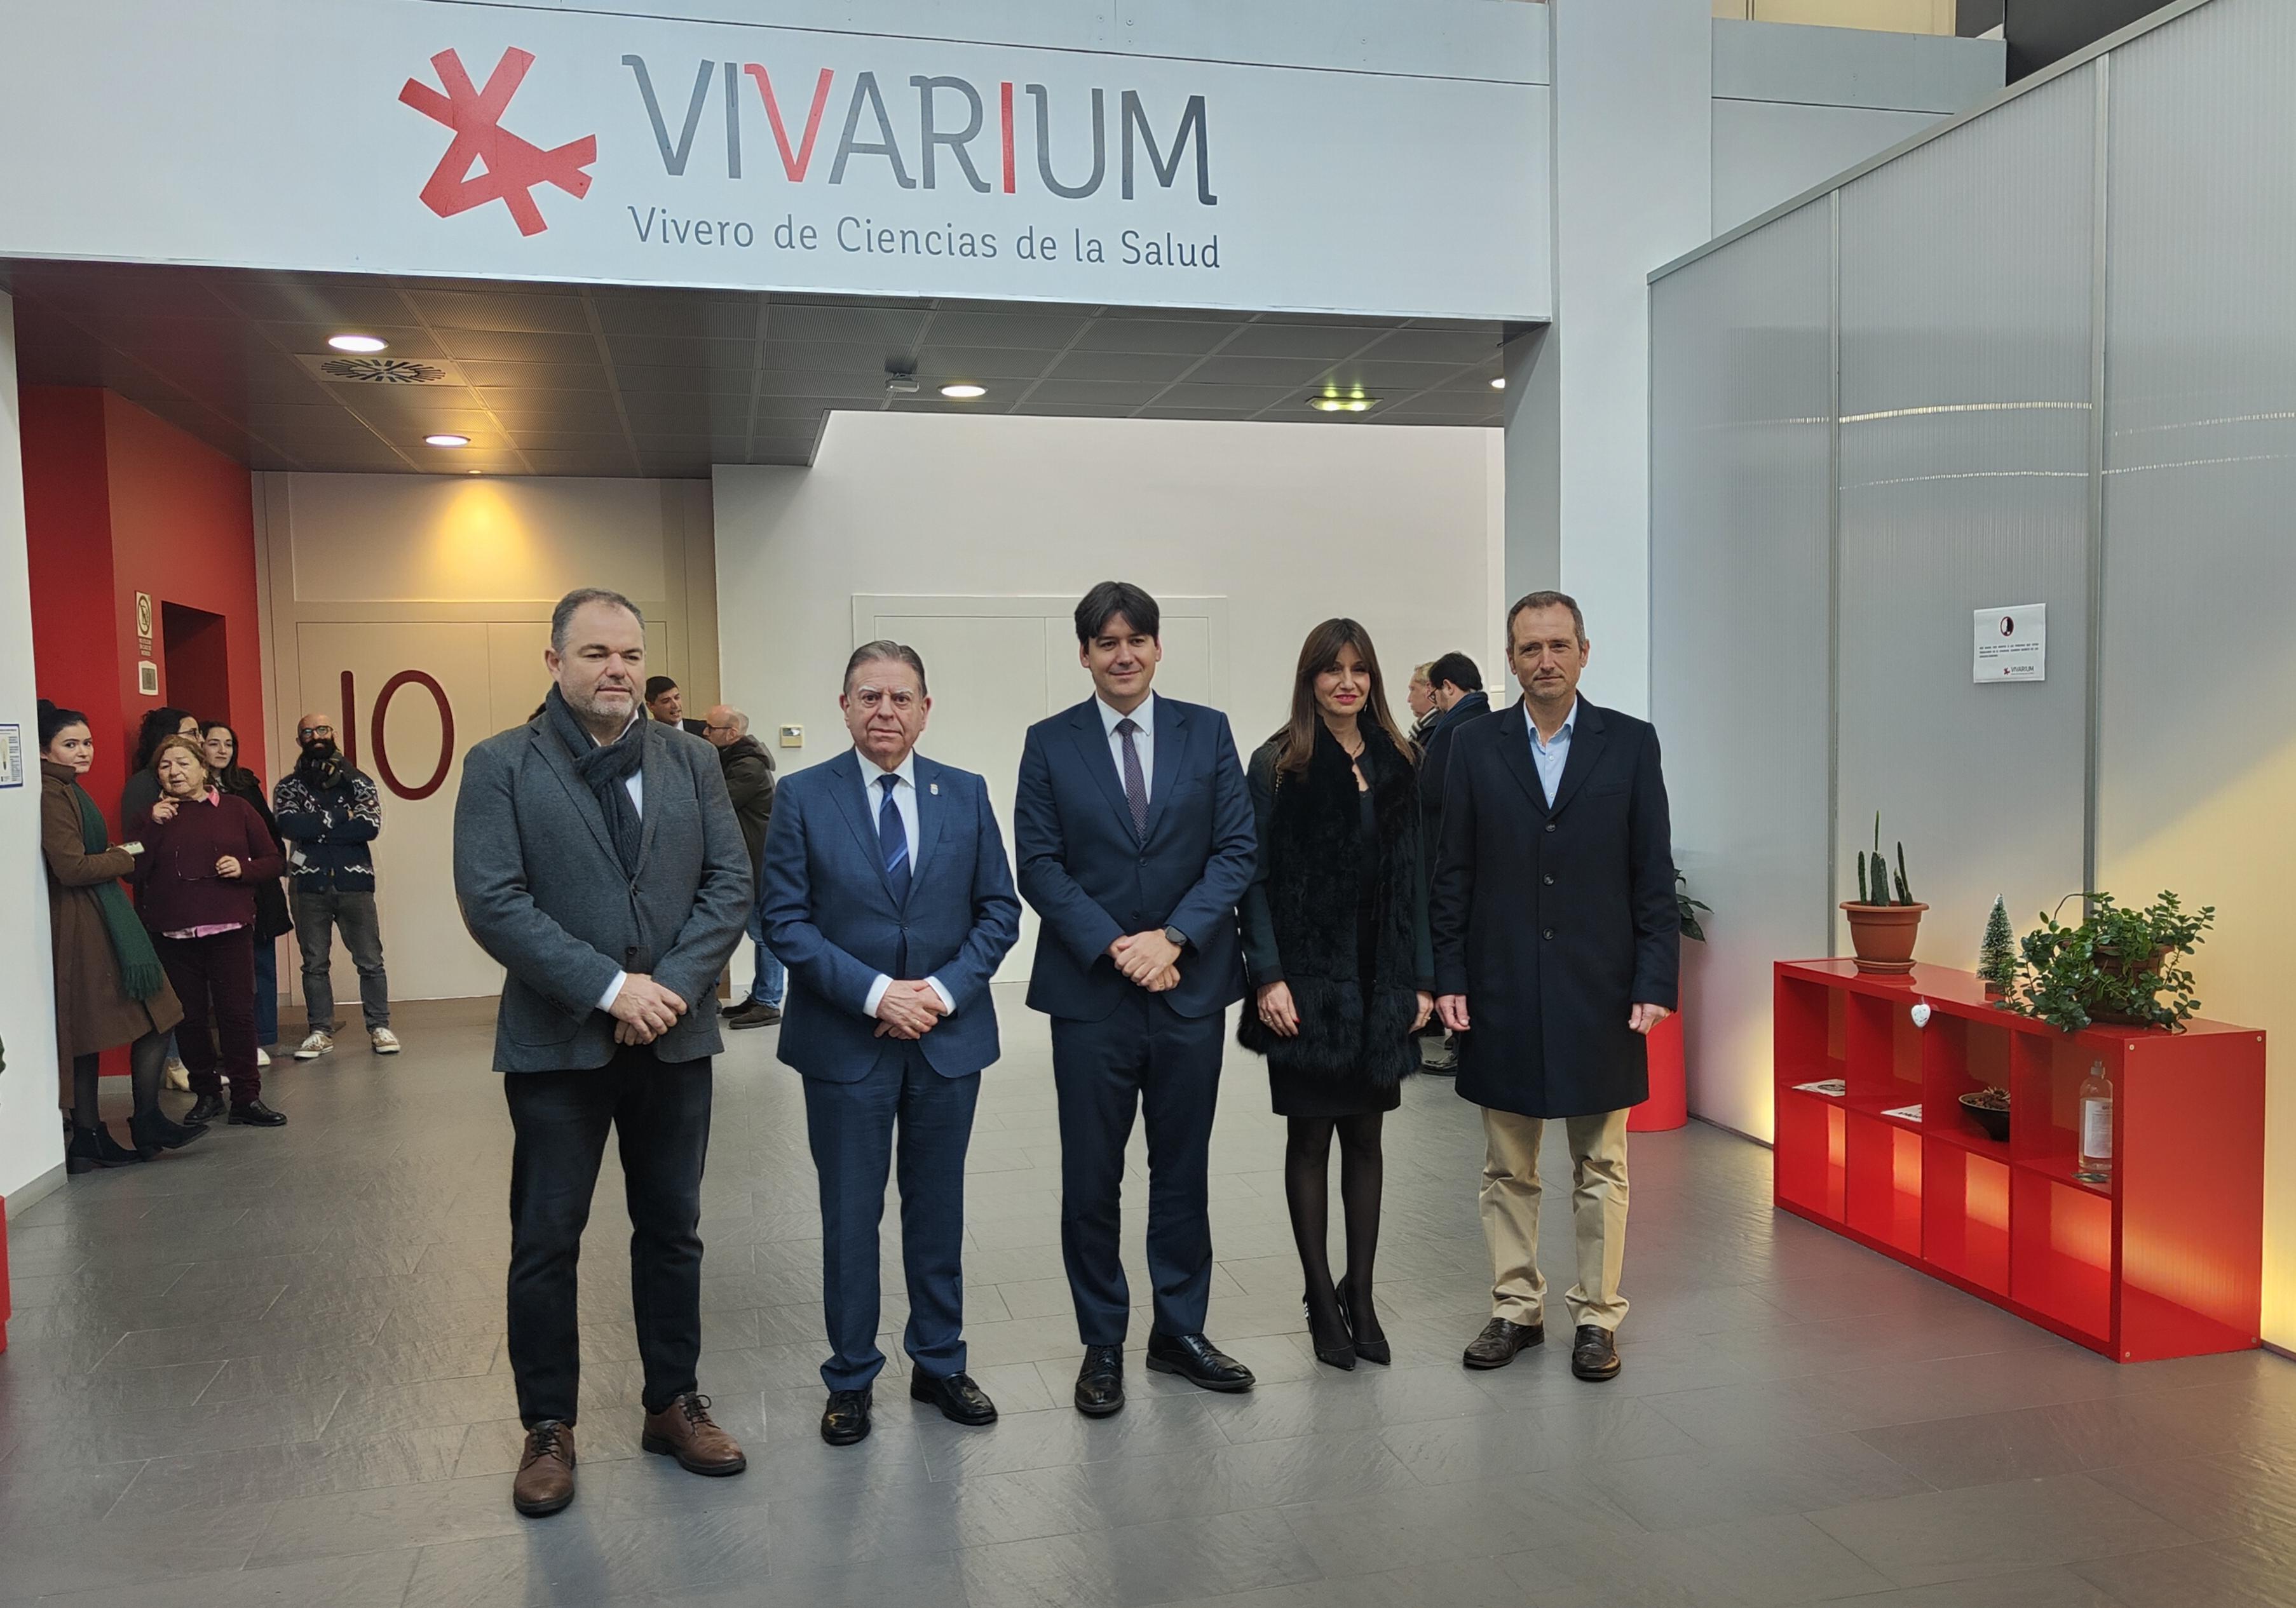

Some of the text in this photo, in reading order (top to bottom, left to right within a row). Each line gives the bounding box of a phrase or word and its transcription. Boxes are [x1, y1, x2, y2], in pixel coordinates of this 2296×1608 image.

[622, 55, 1218, 206] VIVARIUM
[627, 205, 1220, 269] Vivero de Ciencias de la Salud
